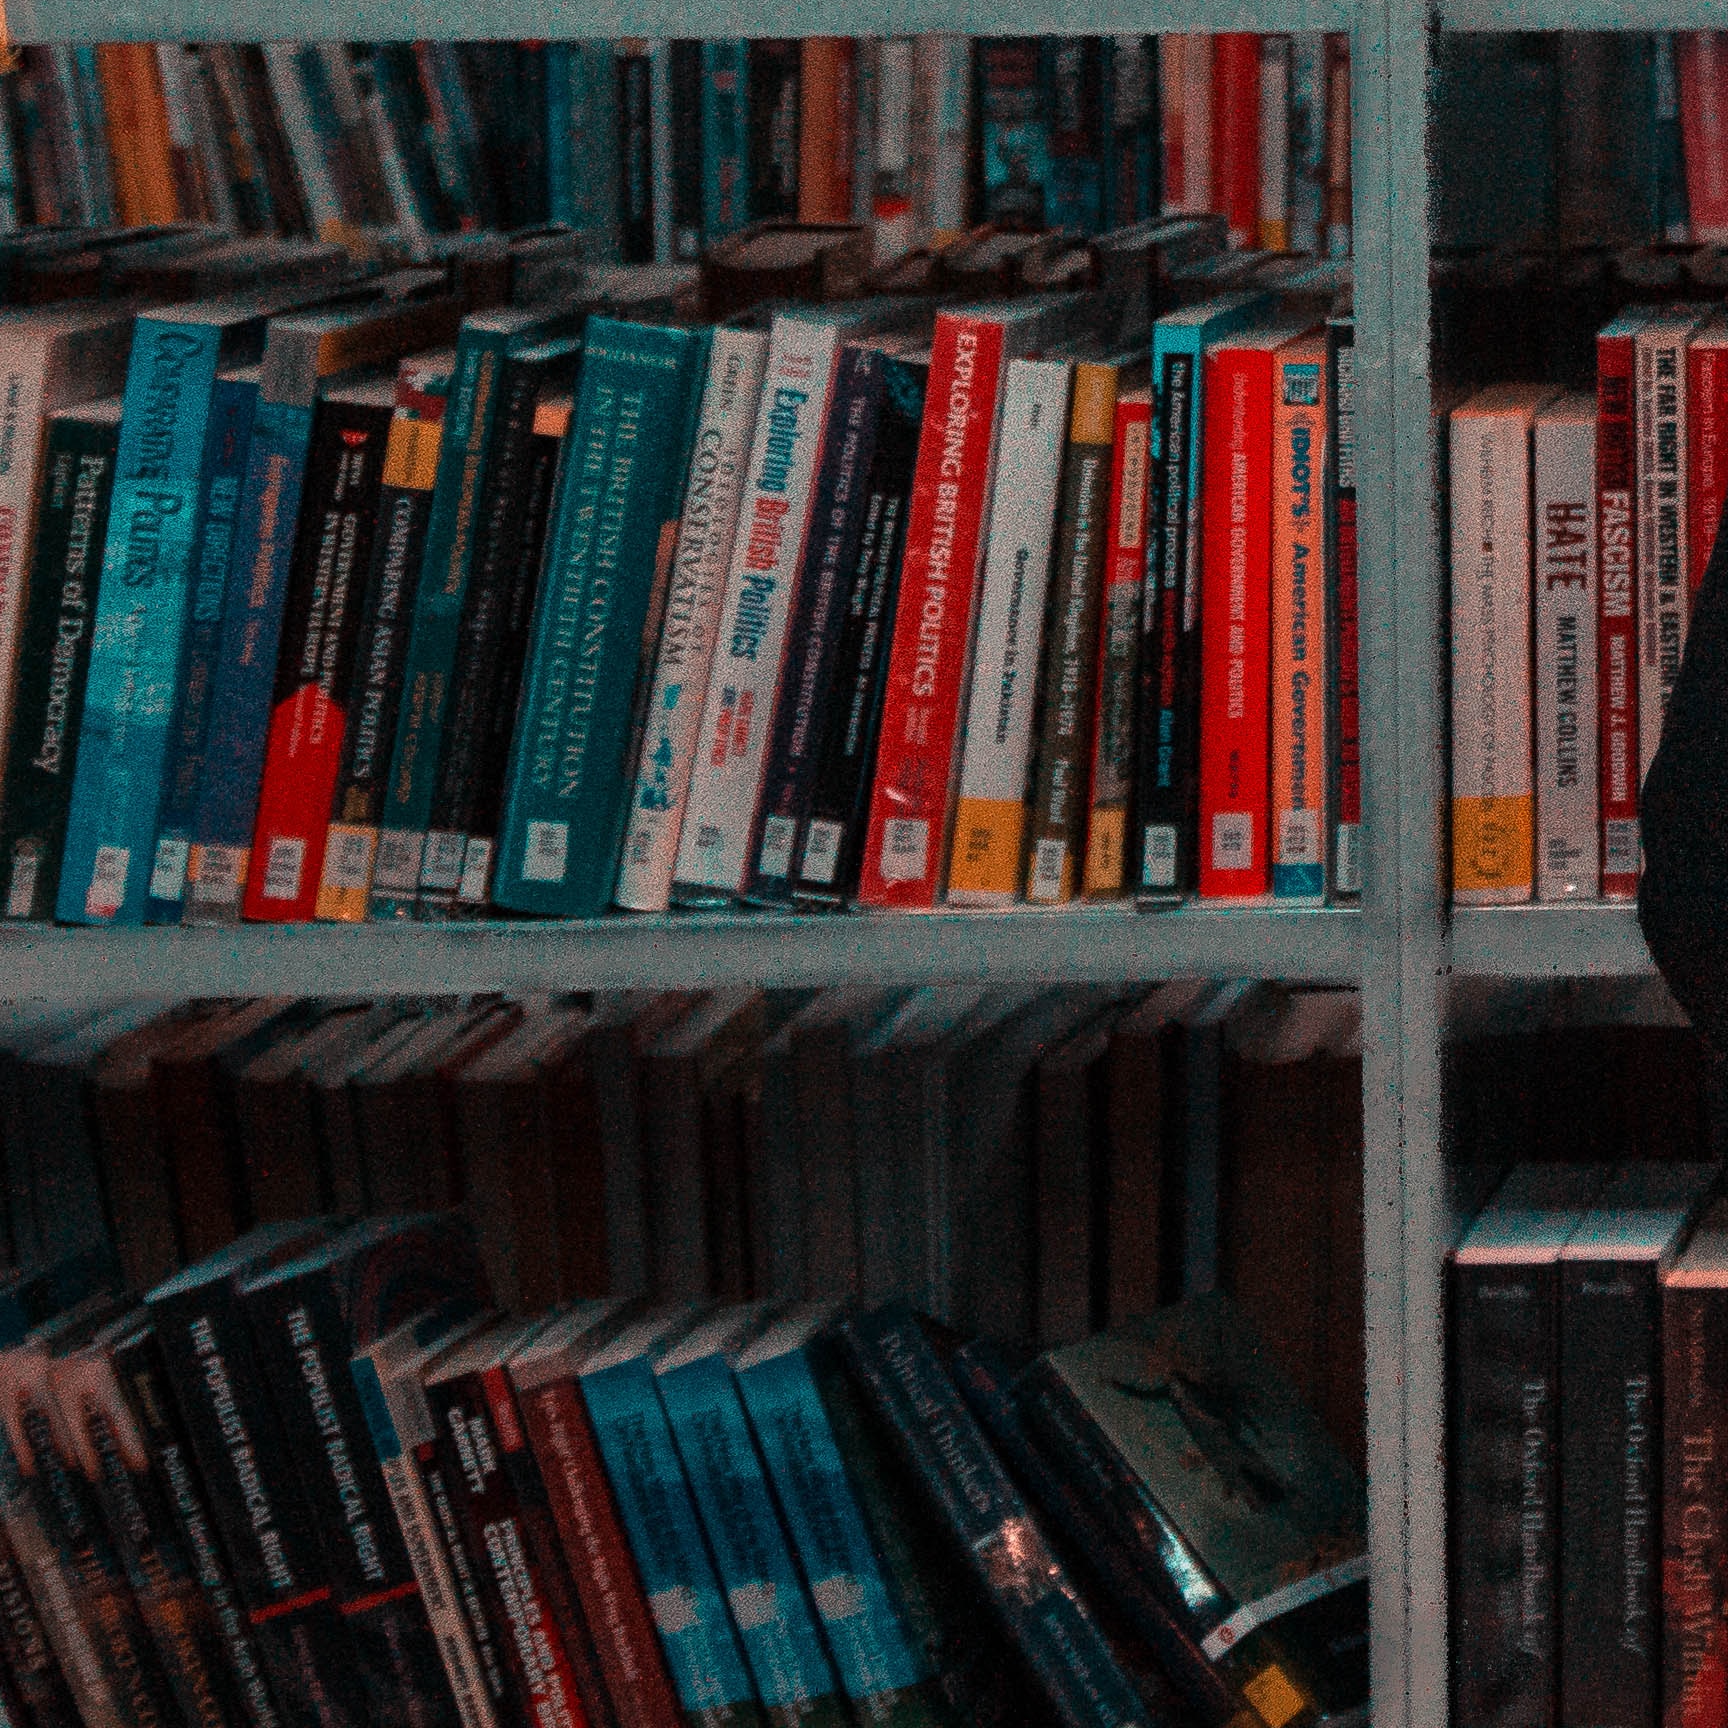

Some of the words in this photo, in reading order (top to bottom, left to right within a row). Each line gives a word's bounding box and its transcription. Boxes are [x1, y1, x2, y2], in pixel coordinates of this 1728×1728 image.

[758, 388, 808, 492] Exploring
[940, 334, 977, 477] EXPLORING
[66, 455, 105, 575] Patterns
[376, 497, 412, 619] COMPARING
[660, 429, 722, 666] CONSERVATISM
[743, 498, 786, 570] British
[924, 485, 956, 580] BRITISH
[1547, 503, 1586, 592] HATE
[63, 582, 89, 611] of
[730, 577, 775, 662] Politics
[913, 586, 943, 697] POLITICS
[32, 615, 84, 774] Democracy
[369, 626, 394, 681] ASIAN
[1557, 618, 1577, 706] MATTHEW
[353, 690, 384, 778] POLITICS
[1559, 713, 1577, 788] COLLINS
[189, 1318, 215, 1355] THE
[205, 1358, 249, 1442] POPULIST
[234, 1447, 269, 1526] RADICAL
[259, 1532, 291, 1588] RIGHT
[1683, 1430, 1714, 1479] The
[1683, 1503, 1714, 1591] Clash
[1683, 1600, 1711, 1722] Within
